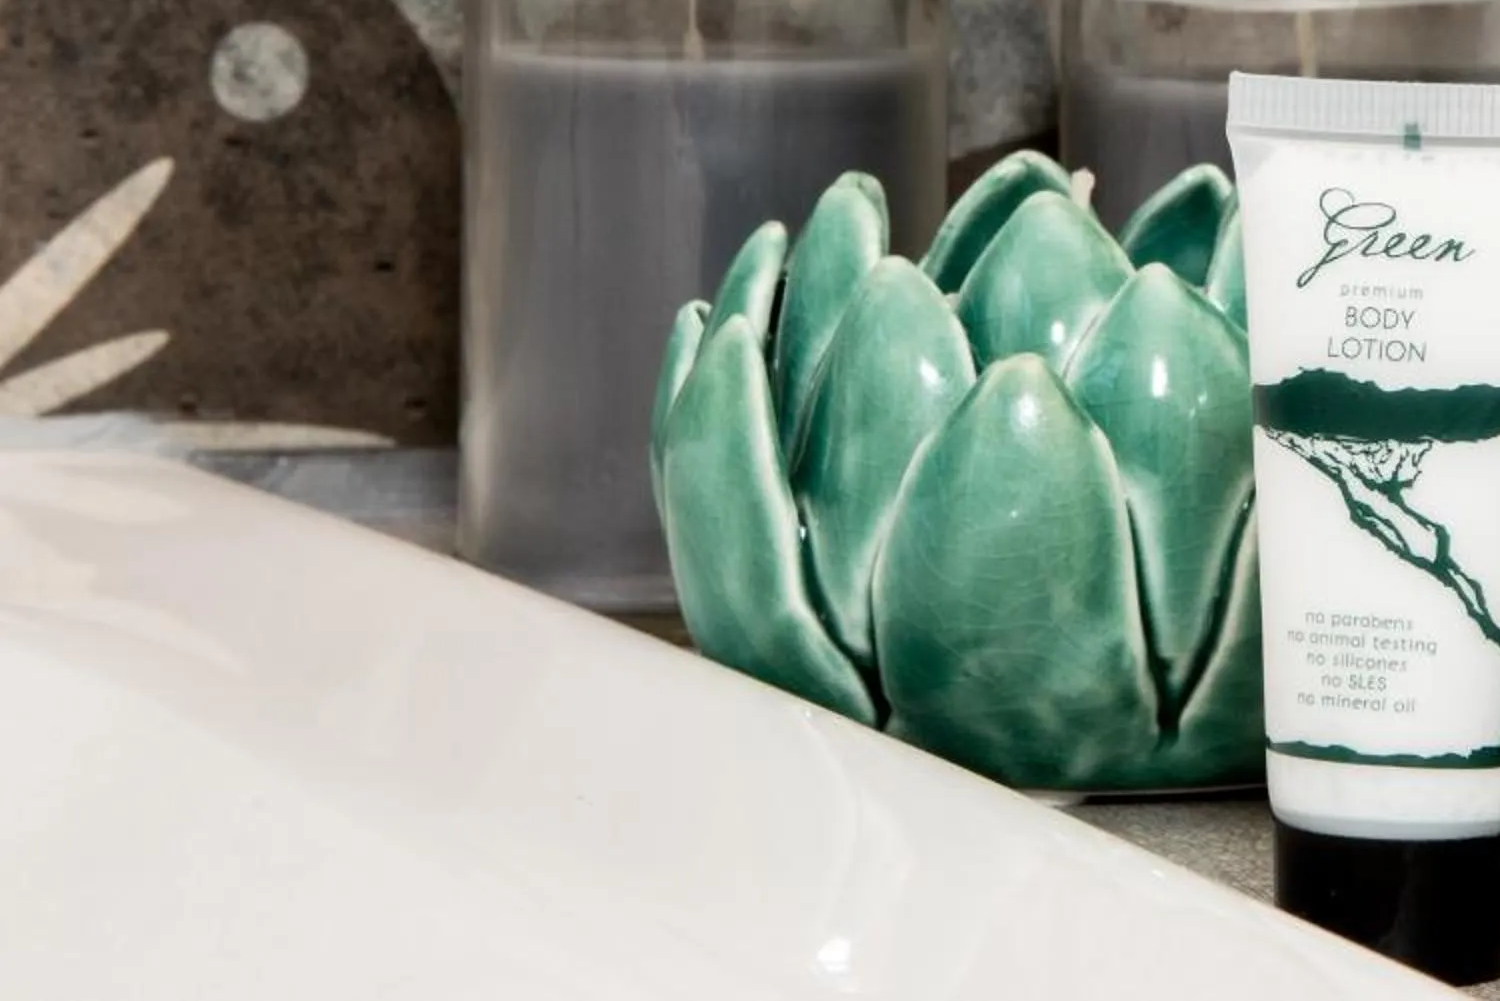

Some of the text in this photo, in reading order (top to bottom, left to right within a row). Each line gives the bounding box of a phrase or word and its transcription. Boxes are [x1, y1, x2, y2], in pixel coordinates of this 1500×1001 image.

[1296, 187, 1476, 288] Green
[1339, 283, 1424, 300] premium
[1345, 306, 1415, 329] BODY
[1327, 336, 1427, 362] LOTION
[1305, 611, 1413, 631] no parabens
[1287, 630, 1437, 655] no animal testing
[1306, 652, 1407, 672] no silicones
[1321, 674, 1387, 691] no SLES
[1298, 692, 1415, 713] no mineral oil
